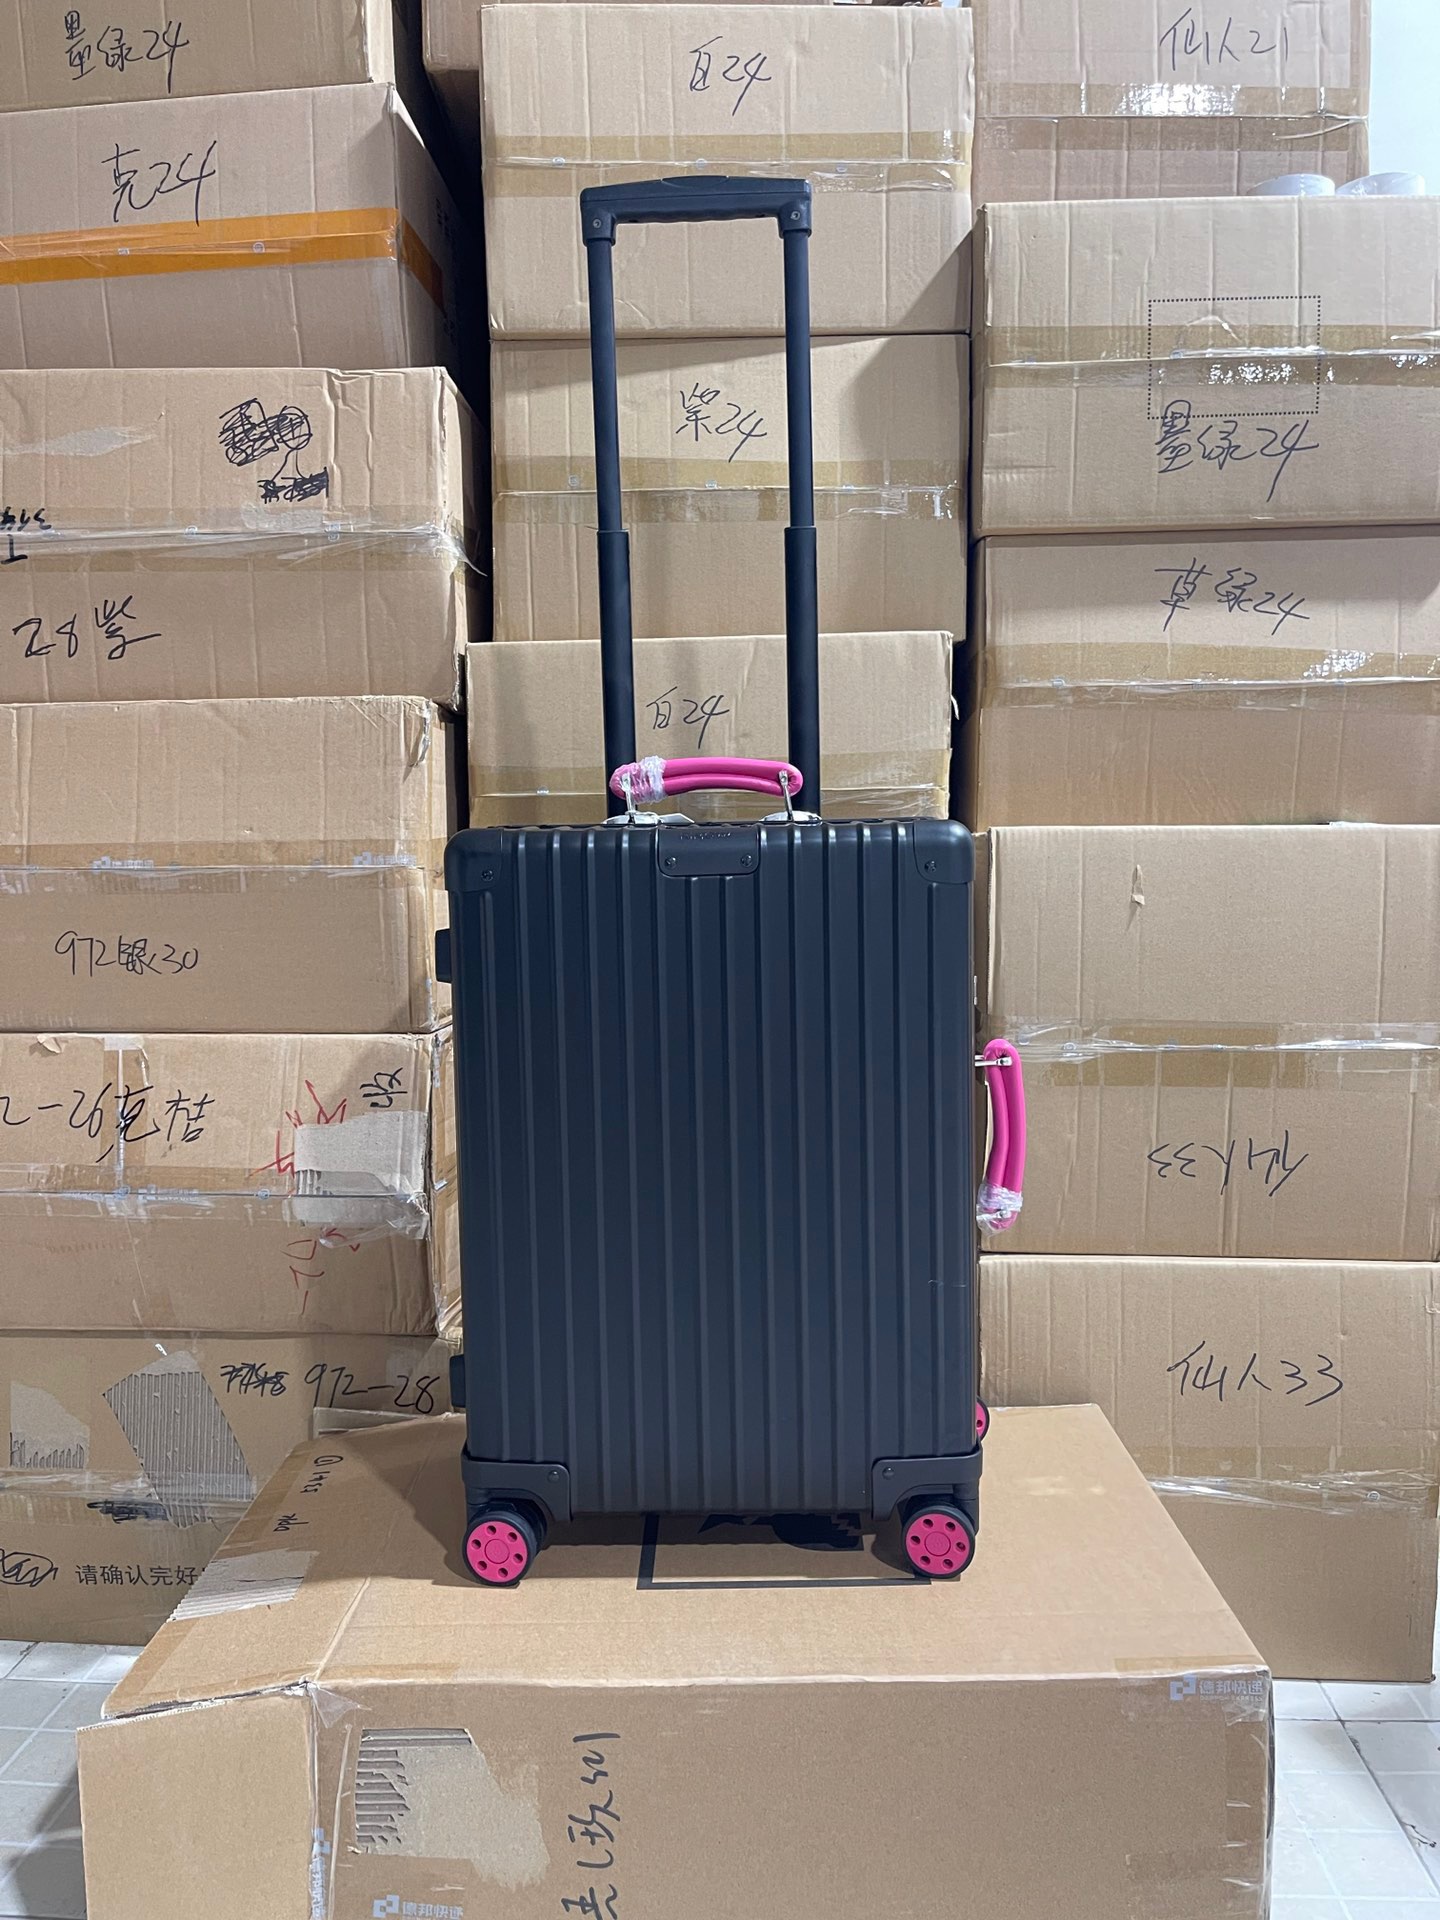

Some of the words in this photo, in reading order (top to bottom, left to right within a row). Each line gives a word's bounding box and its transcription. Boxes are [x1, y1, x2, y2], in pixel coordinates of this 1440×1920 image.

[75, 1563, 207, 1586] 请确认完好
